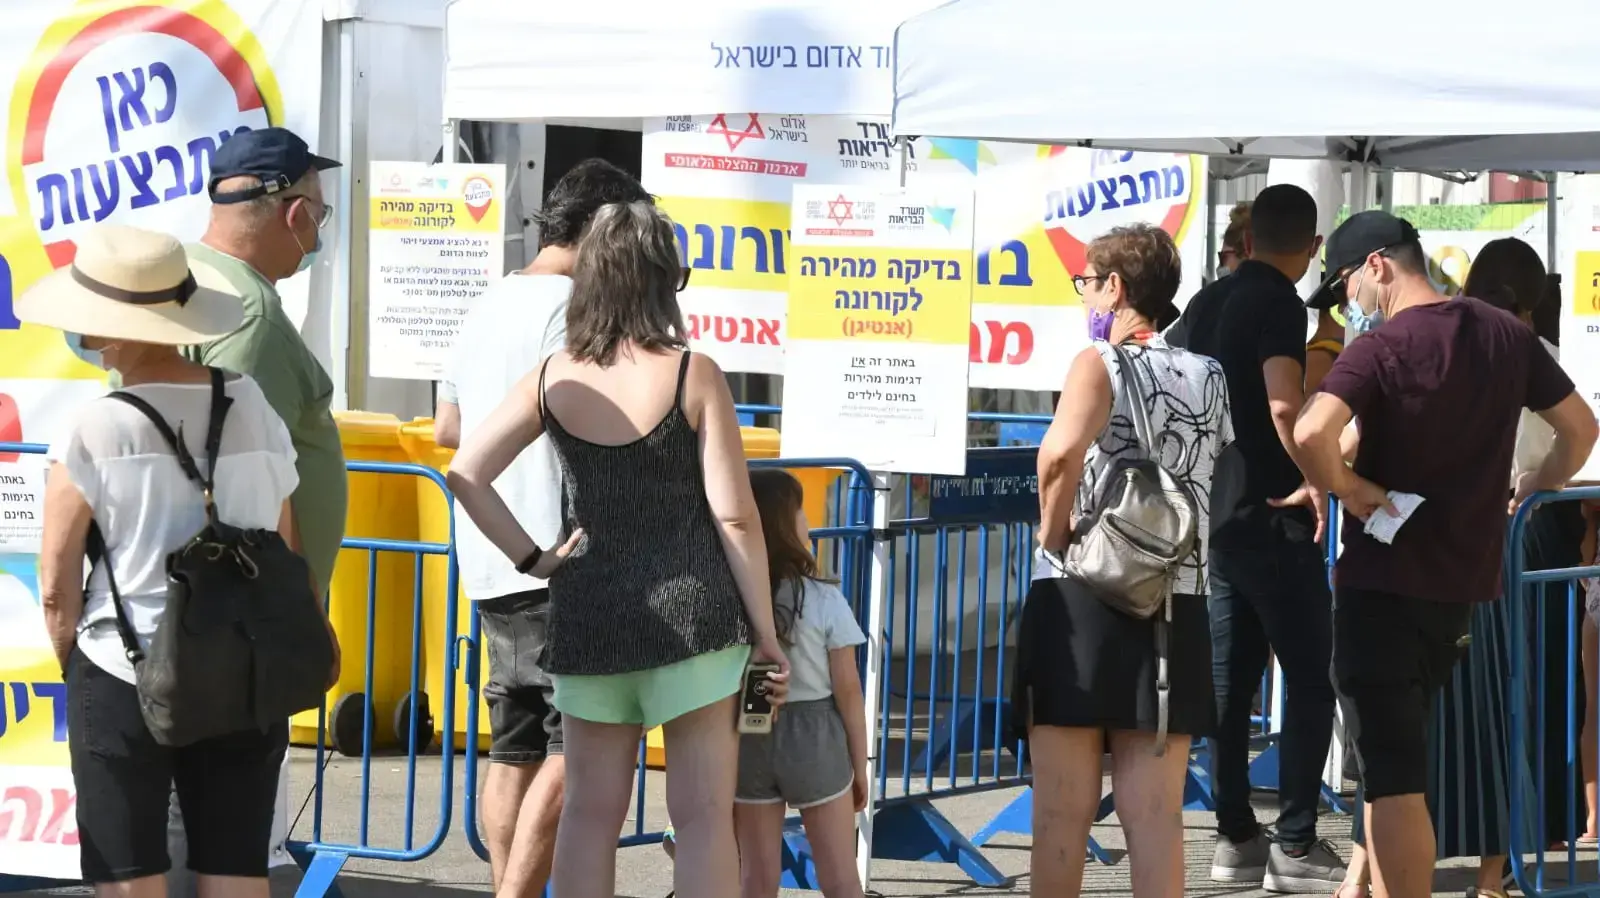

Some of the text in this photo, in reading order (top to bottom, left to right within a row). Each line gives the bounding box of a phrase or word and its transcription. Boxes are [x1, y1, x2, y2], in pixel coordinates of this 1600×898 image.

[710, 42, 890, 68] וד אדום בישראל
[96, 61, 177, 152] כאן
[665, 122, 676, 131] IN
[780, 117, 805, 128] אדום
[769, 127, 808, 142] בישראל
[670, 154, 799, 177] ארגון ההצלה הלאומי
[840, 159, 890, 171] בריאים יותר
[37, 126, 252, 231] תבצעות
[1044, 164, 1185, 222] מתבצעות
[380, 201, 454, 215] בדיקה מהירה
[900, 206, 925, 215] משרד
[413, 215, 456, 229] לקורונה
[888, 215, 924, 225] הבריאות
[400, 237, 418, 245] זיהוי
[419, 238, 445, 246] אמצעי
[446, 237, 470, 246] להציג
[466, 249, 489, 258] לצוות
[674, 222, 791, 274] ורונ
[800, 256, 877, 279] מהירה
[887, 259, 961, 285] בדיקה
[834, 287, 924, 317] לקורונה
[686, 313, 781, 346] אנטיג
[842, 316, 913, 338] (אנטיגן)
[851, 355, 915, 368] באתר זה אין
[844, 373, 922, 385] דגימות מהירות
[847, 390, 916, 402] בחינם לילדים
[1, 493, 35, 503] דגימות
[4, 510, 35, 520] בחינם
